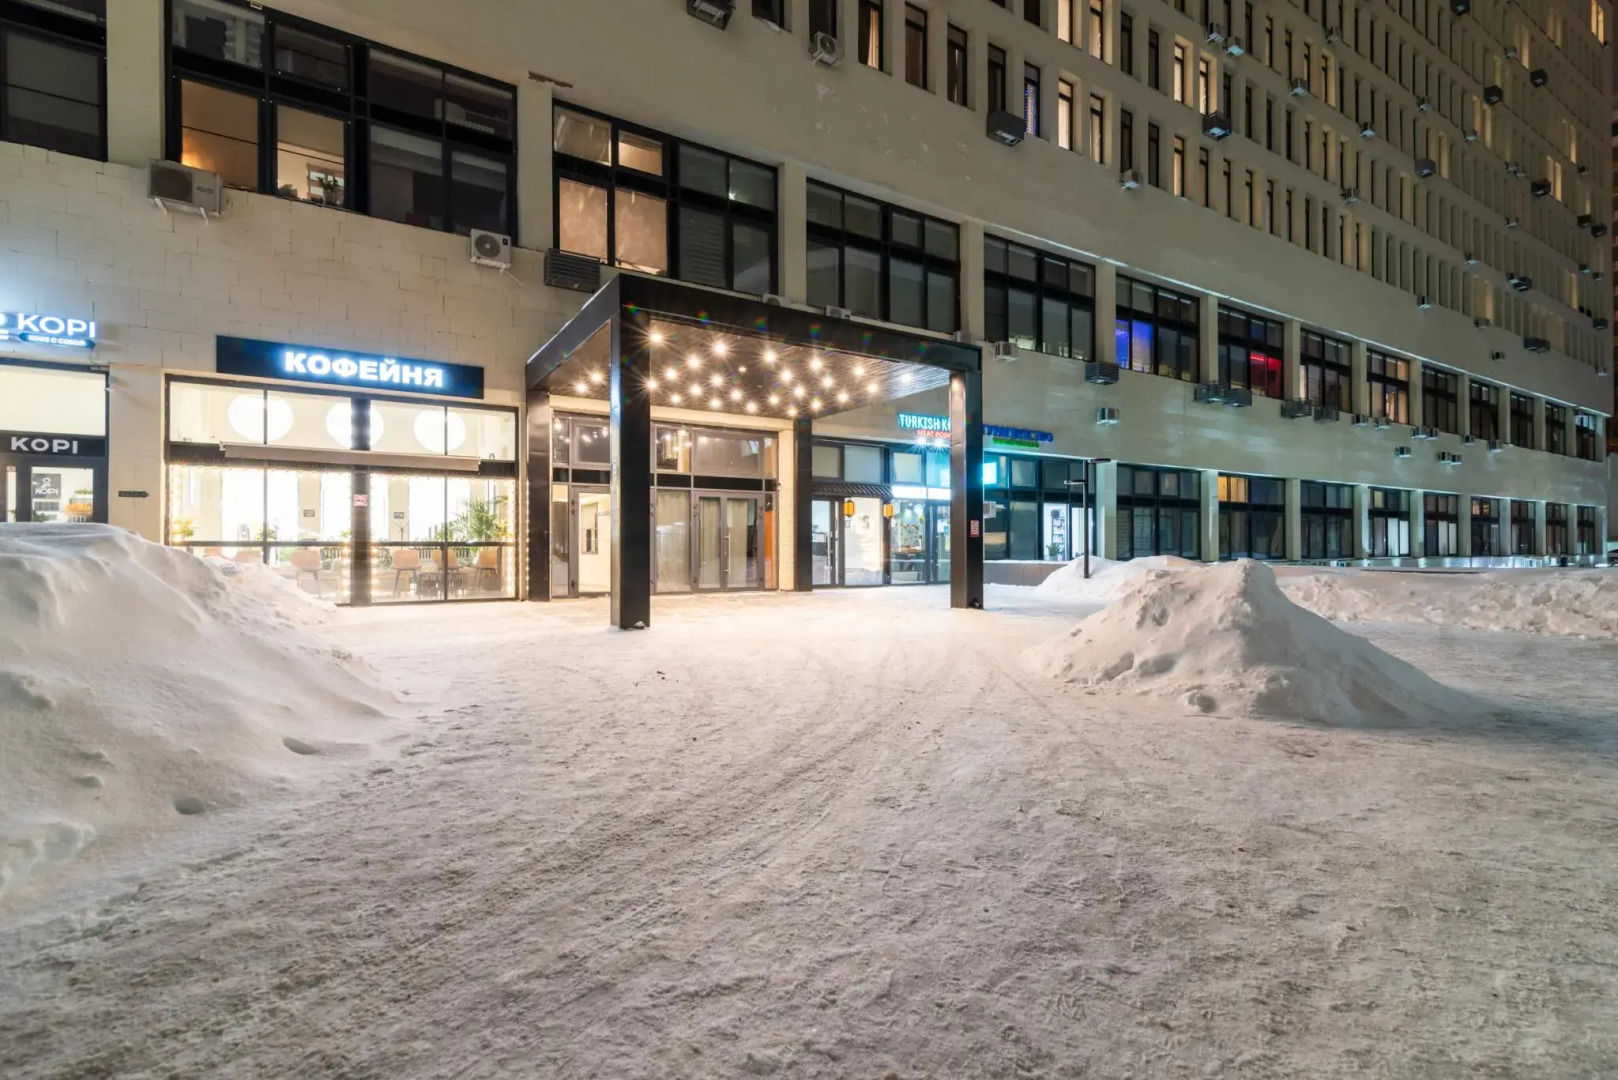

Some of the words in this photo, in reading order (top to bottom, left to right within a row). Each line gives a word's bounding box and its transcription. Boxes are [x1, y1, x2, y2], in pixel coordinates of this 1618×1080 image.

[17, 312, 96, 339] KOPI
[283, 351, 443, 388] КОФЕЙНЯ
[898, 413, 940, 431] TURKISH
[11, 436, 78, 454] KOPI
[35, 487, 59, 495] KOPI
